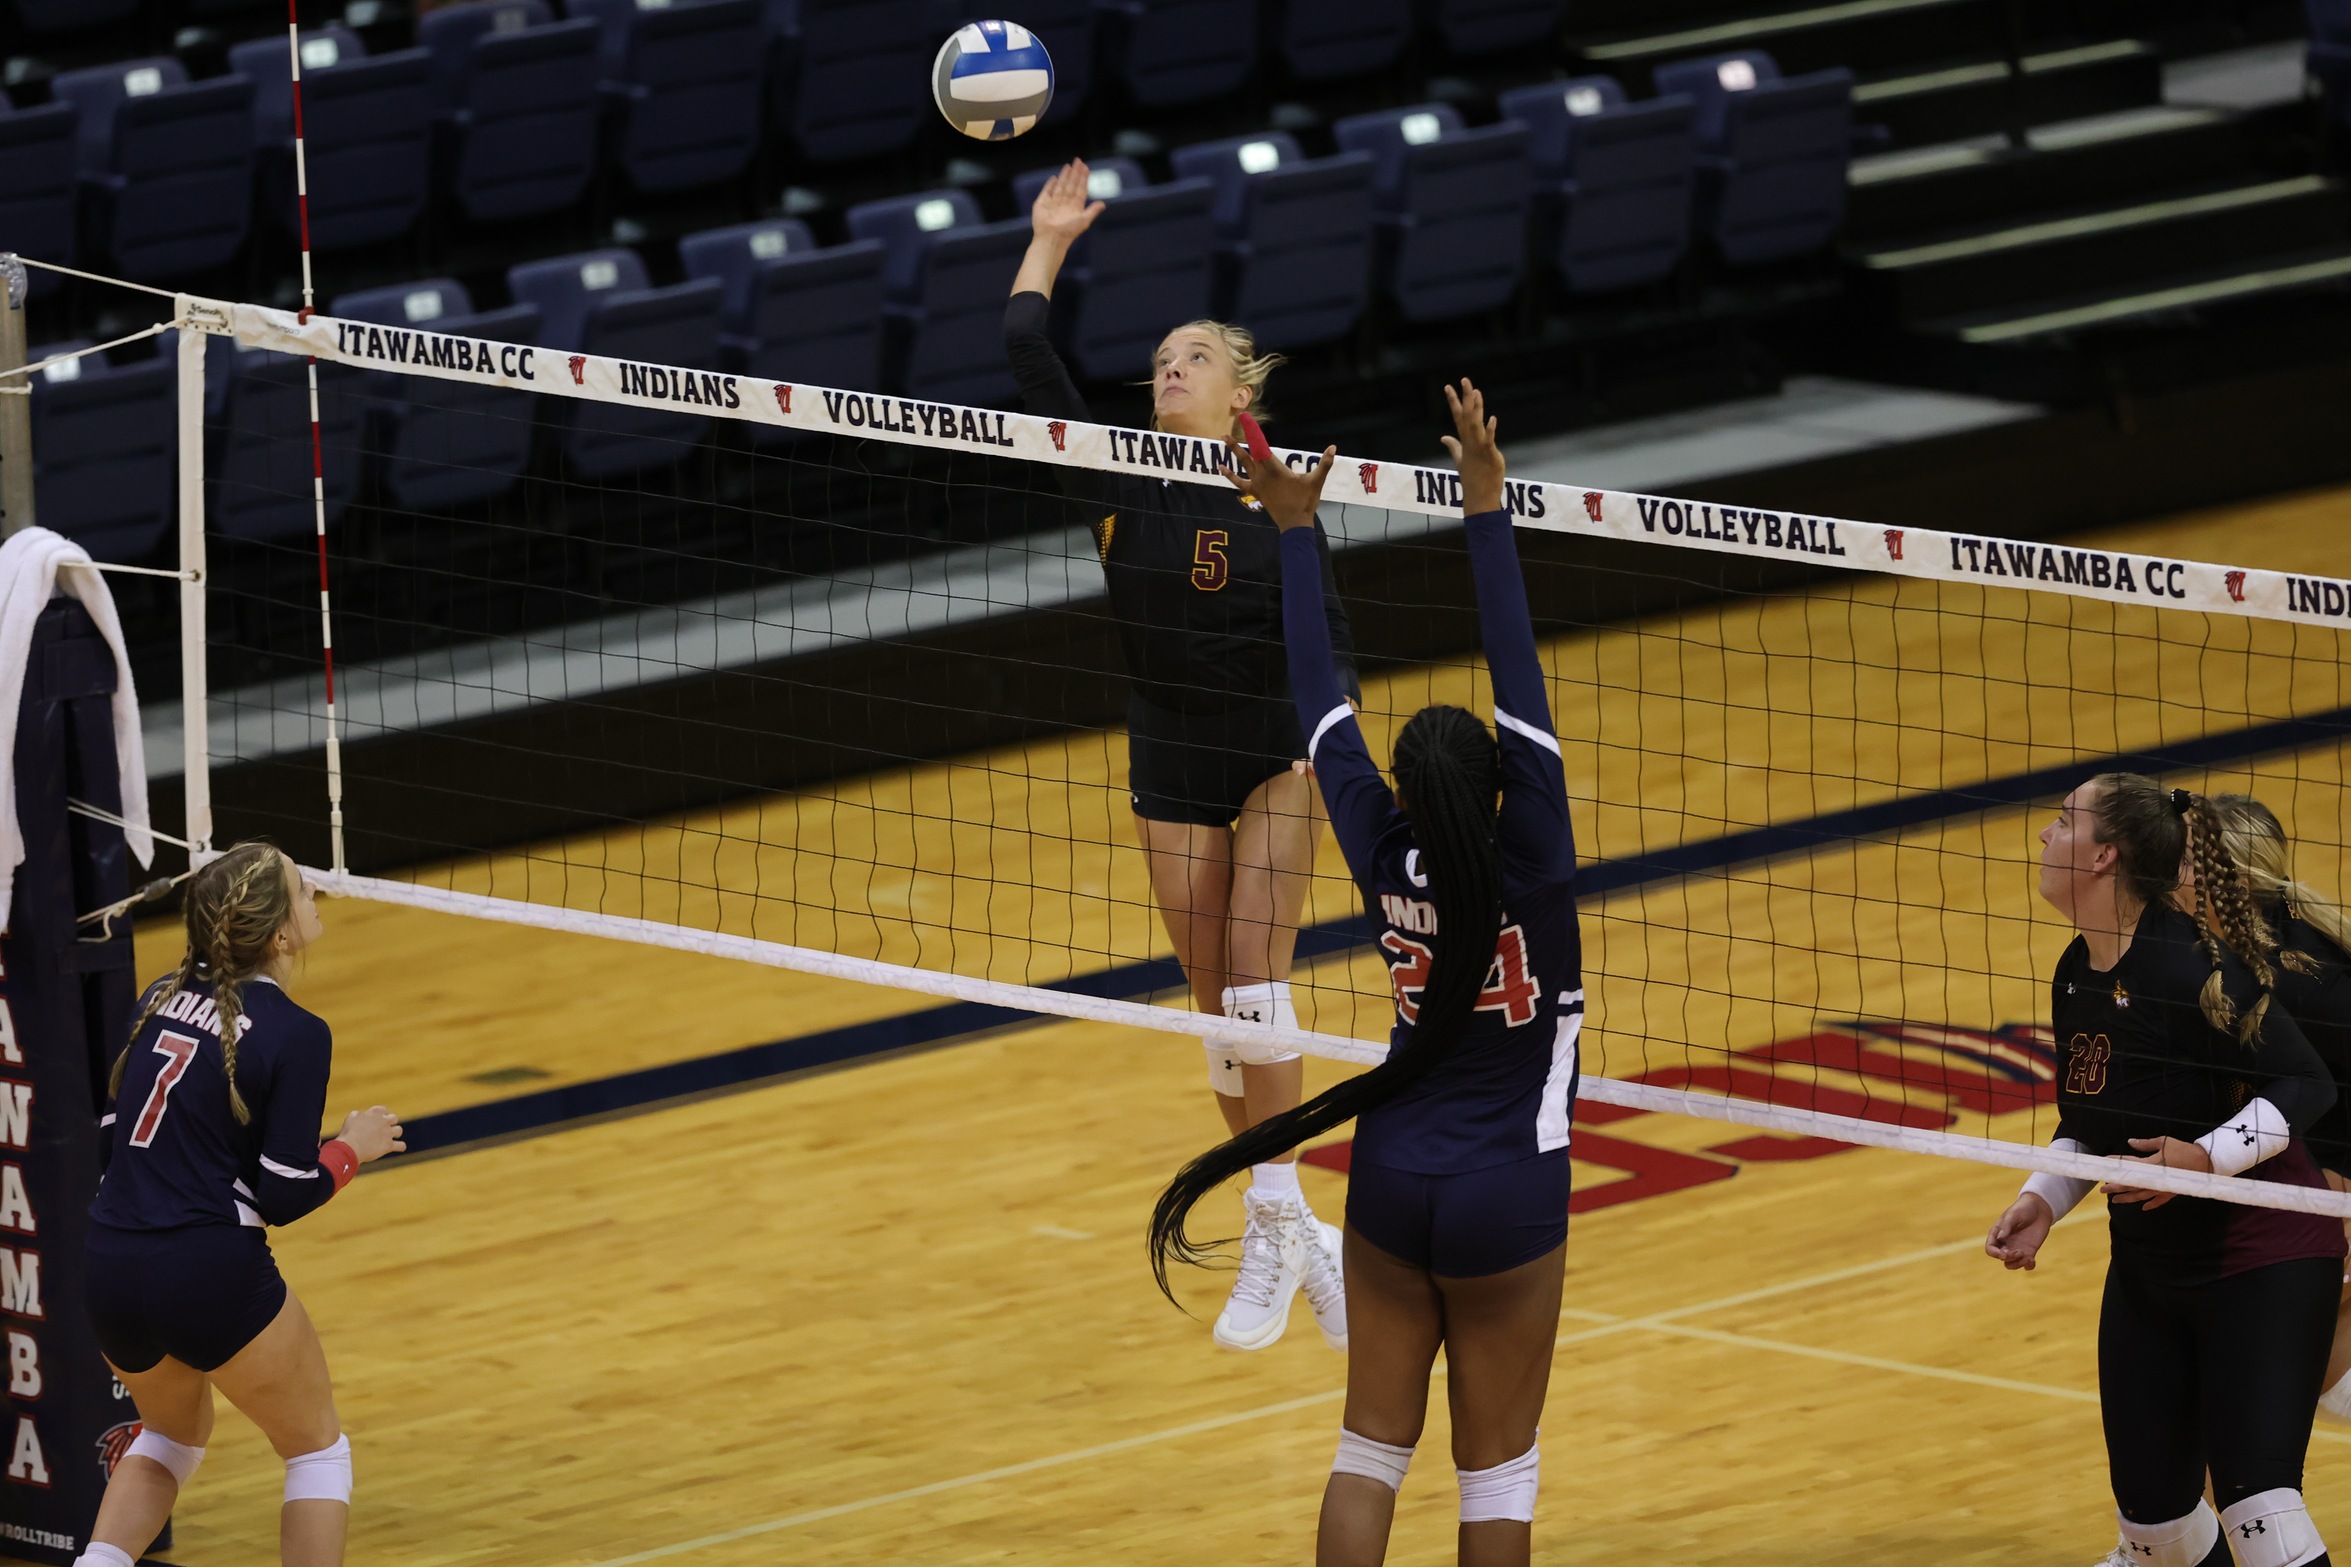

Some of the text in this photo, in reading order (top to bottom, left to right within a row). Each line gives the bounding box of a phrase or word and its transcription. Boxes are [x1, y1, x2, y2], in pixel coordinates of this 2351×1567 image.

[339, 322, 534, 381] ITAWAMBA CC
[620, 363, 739, 409] INDIANS
[822, 391, 1013, 447] VOLLEYBALL
[1109, 430, 1252, 480] ITAWAM
[1414, 470, 1545, 519] INDNS
[1637, 498, 1845, 557] VOLLEYBALL
[1191, 529, 1228, 591] 5
[1951, 538, 2185, 599] ITAWAMBA CC
[1381, 929, 1541, 1029] 24
[129, 1029, 200, 1148] 7
[2065, 1033, 2111, 1094] 20
